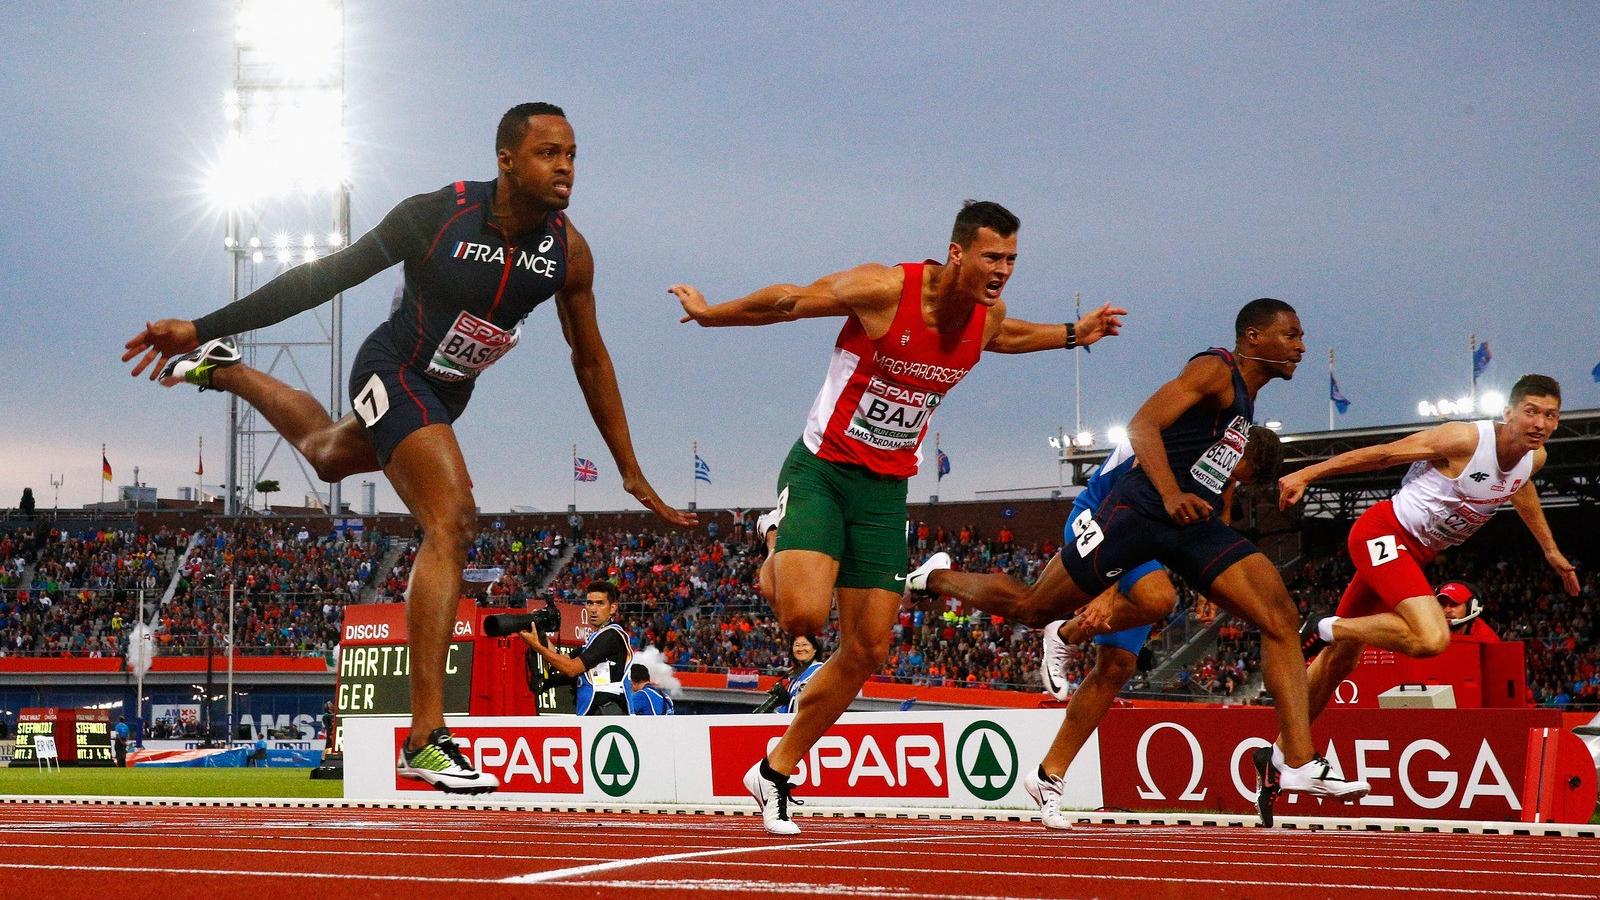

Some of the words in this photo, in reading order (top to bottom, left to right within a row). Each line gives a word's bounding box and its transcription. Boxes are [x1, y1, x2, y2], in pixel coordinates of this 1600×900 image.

[361, 387, 378, 419] 7
[870, 379, 925, 407] SPAR
[847, 426, 902, 449] AMSTERDAM
[1206, 443, 1238, 472] BELOC
[1469, 471, 1490, 483] 4F
[1080, 530, 1097, 546] 4
[1374, 540, 1389, 561] 2
[345, 623, 390, 640] DISCUS
[337, 683, 375, 710] GER
